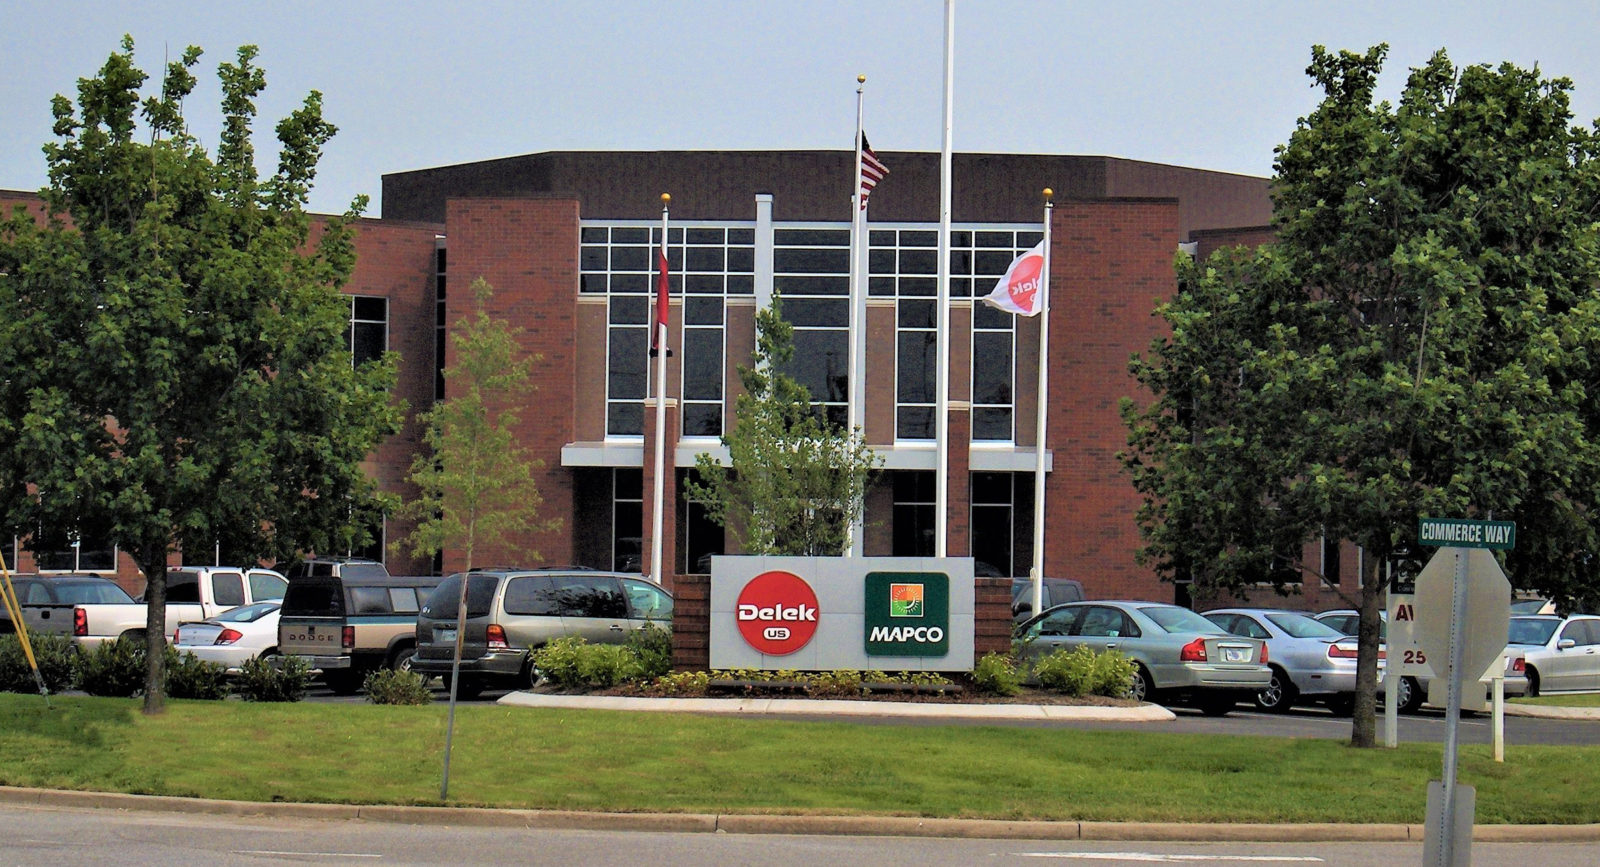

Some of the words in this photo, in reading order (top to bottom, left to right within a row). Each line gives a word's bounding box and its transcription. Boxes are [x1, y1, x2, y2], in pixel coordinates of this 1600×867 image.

[1421, 522, 1482, 543] COMMERCE
[1484, 524, 1512, 544] WAY
[738, 603, 817, 622] Delek
[289, 633, 334, 641] DODGE
[767, 629, 787, 639] US
[869, 626, 944, 643] MAPCO
